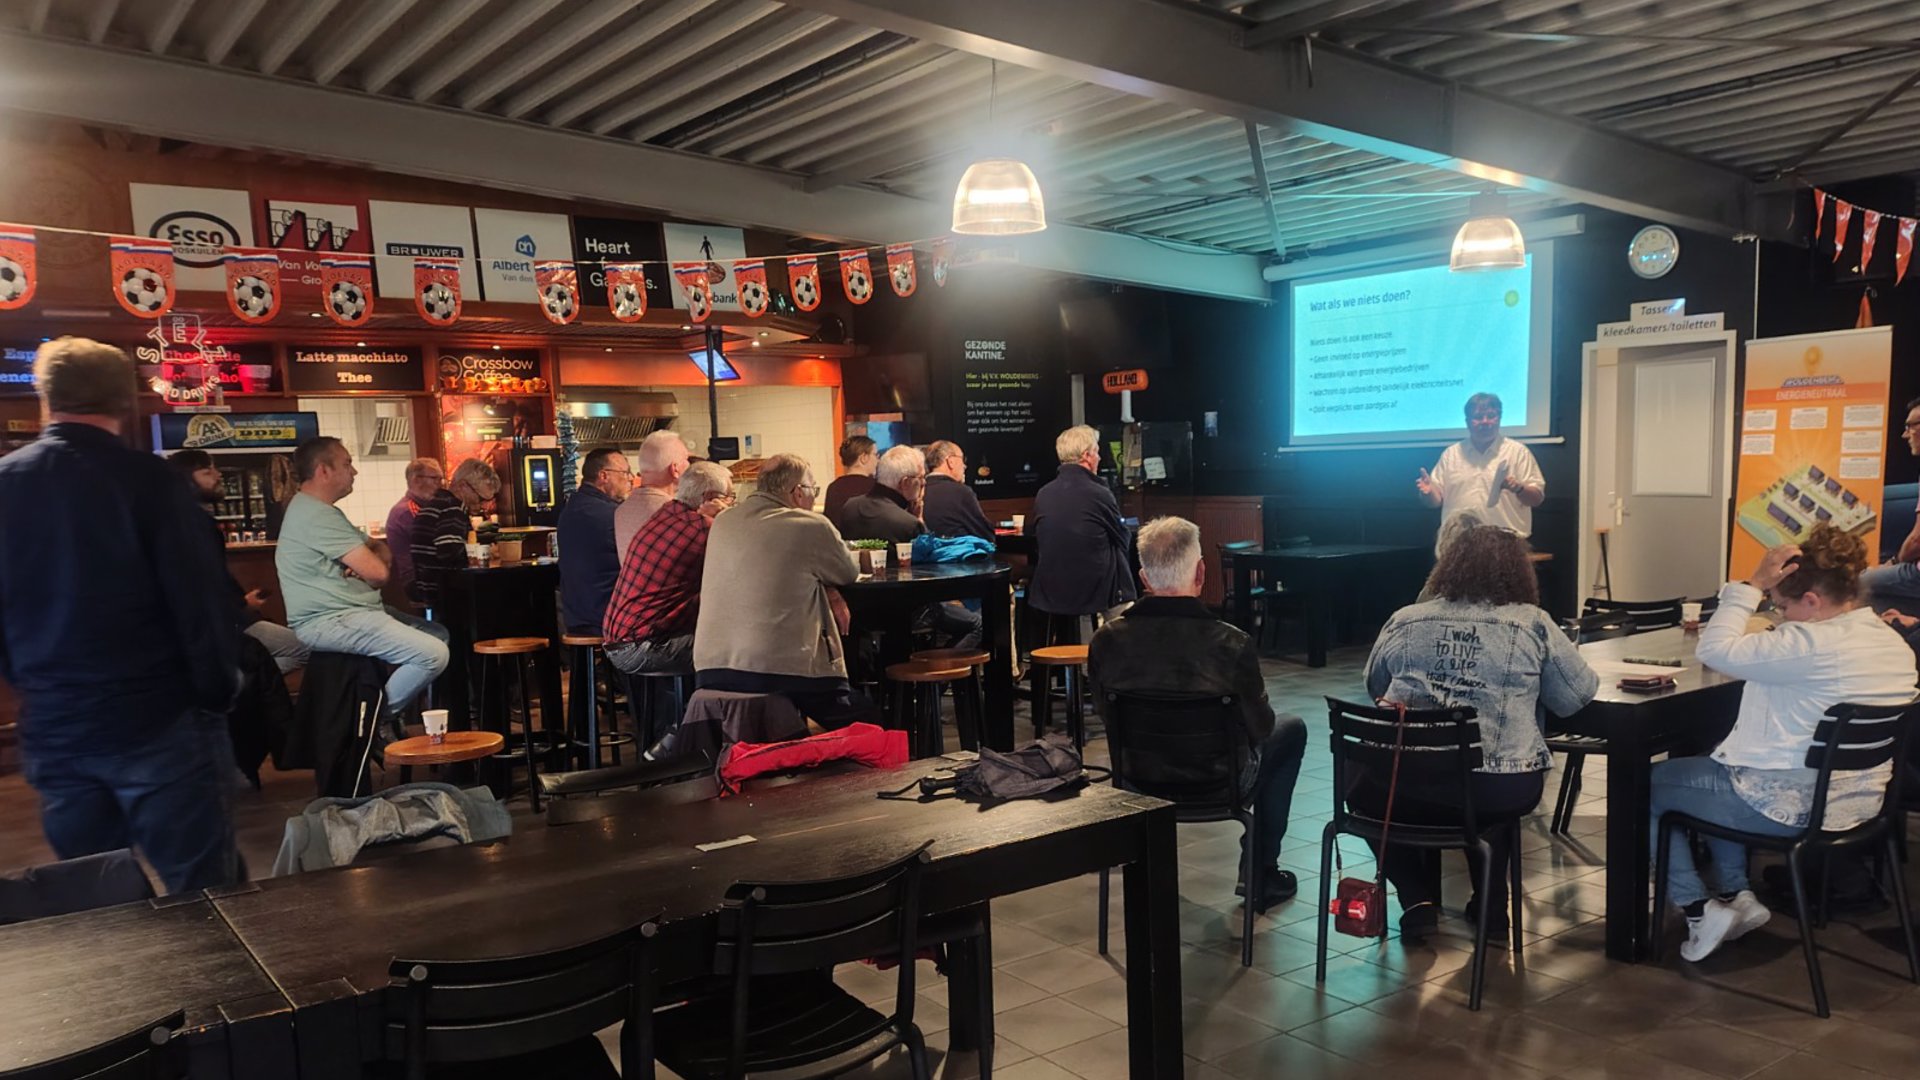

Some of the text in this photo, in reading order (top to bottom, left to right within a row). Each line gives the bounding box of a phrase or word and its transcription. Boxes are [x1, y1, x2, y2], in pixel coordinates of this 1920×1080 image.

[585, 237, 631, 255] Heart
[278, 259, 321, 271] Van Vo
[502, 273, 518, 282] Van
[519, 273, 534, 283] den
[1310, 289, 1412, 312] Wat als we niets doen?
[1603, 318, 1717, 337] kleedkamers/toiletten
[964, 340, 1007, 351] GEZONDE
[296, 351, 408, 364] Latte macchiato
[965, 350, 1006, 361] KANTINE.
[462, 355, 534, 371] Crossbow
[336, 371, 373, 383] Thee
[462, 369, 512, 381] Coffee
[182, 375, 221, 400] DRINKS
[1775, 388, 1848, 401] ENERGIENEUTRAAL
[202, 421, 221, 436] AA
[199, 433, 227, 445] DRINK
[1440, 624, 1480, 644] I wish
[1433, 641, 1483, 660] to LIVE
[1434, 658, 1478, 676] a life
